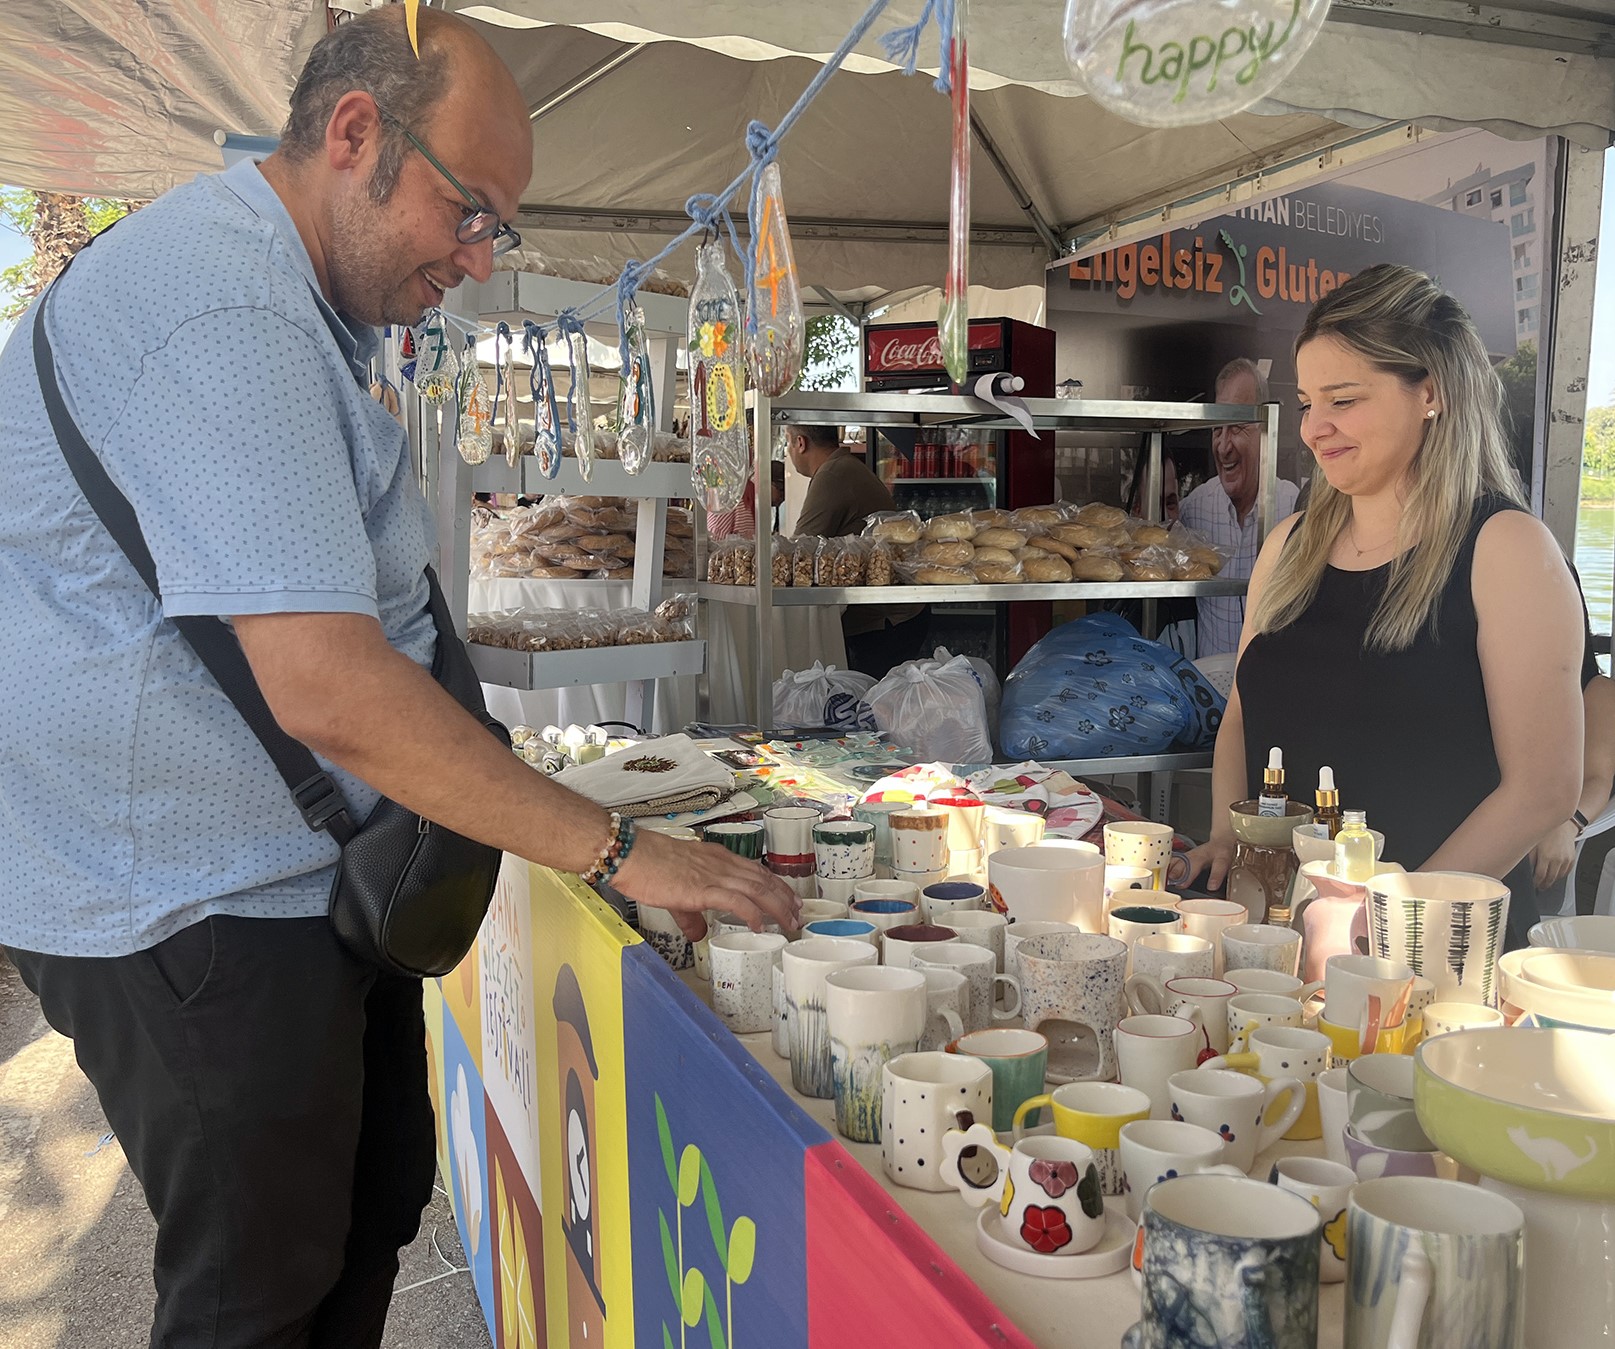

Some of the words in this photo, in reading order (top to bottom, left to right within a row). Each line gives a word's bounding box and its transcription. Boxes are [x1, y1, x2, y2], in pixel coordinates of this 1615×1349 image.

[1115, 0, 1300, 103] happy
[1226, 197, 1290, 226] HAN
[694, 361, 738, 438] 10
